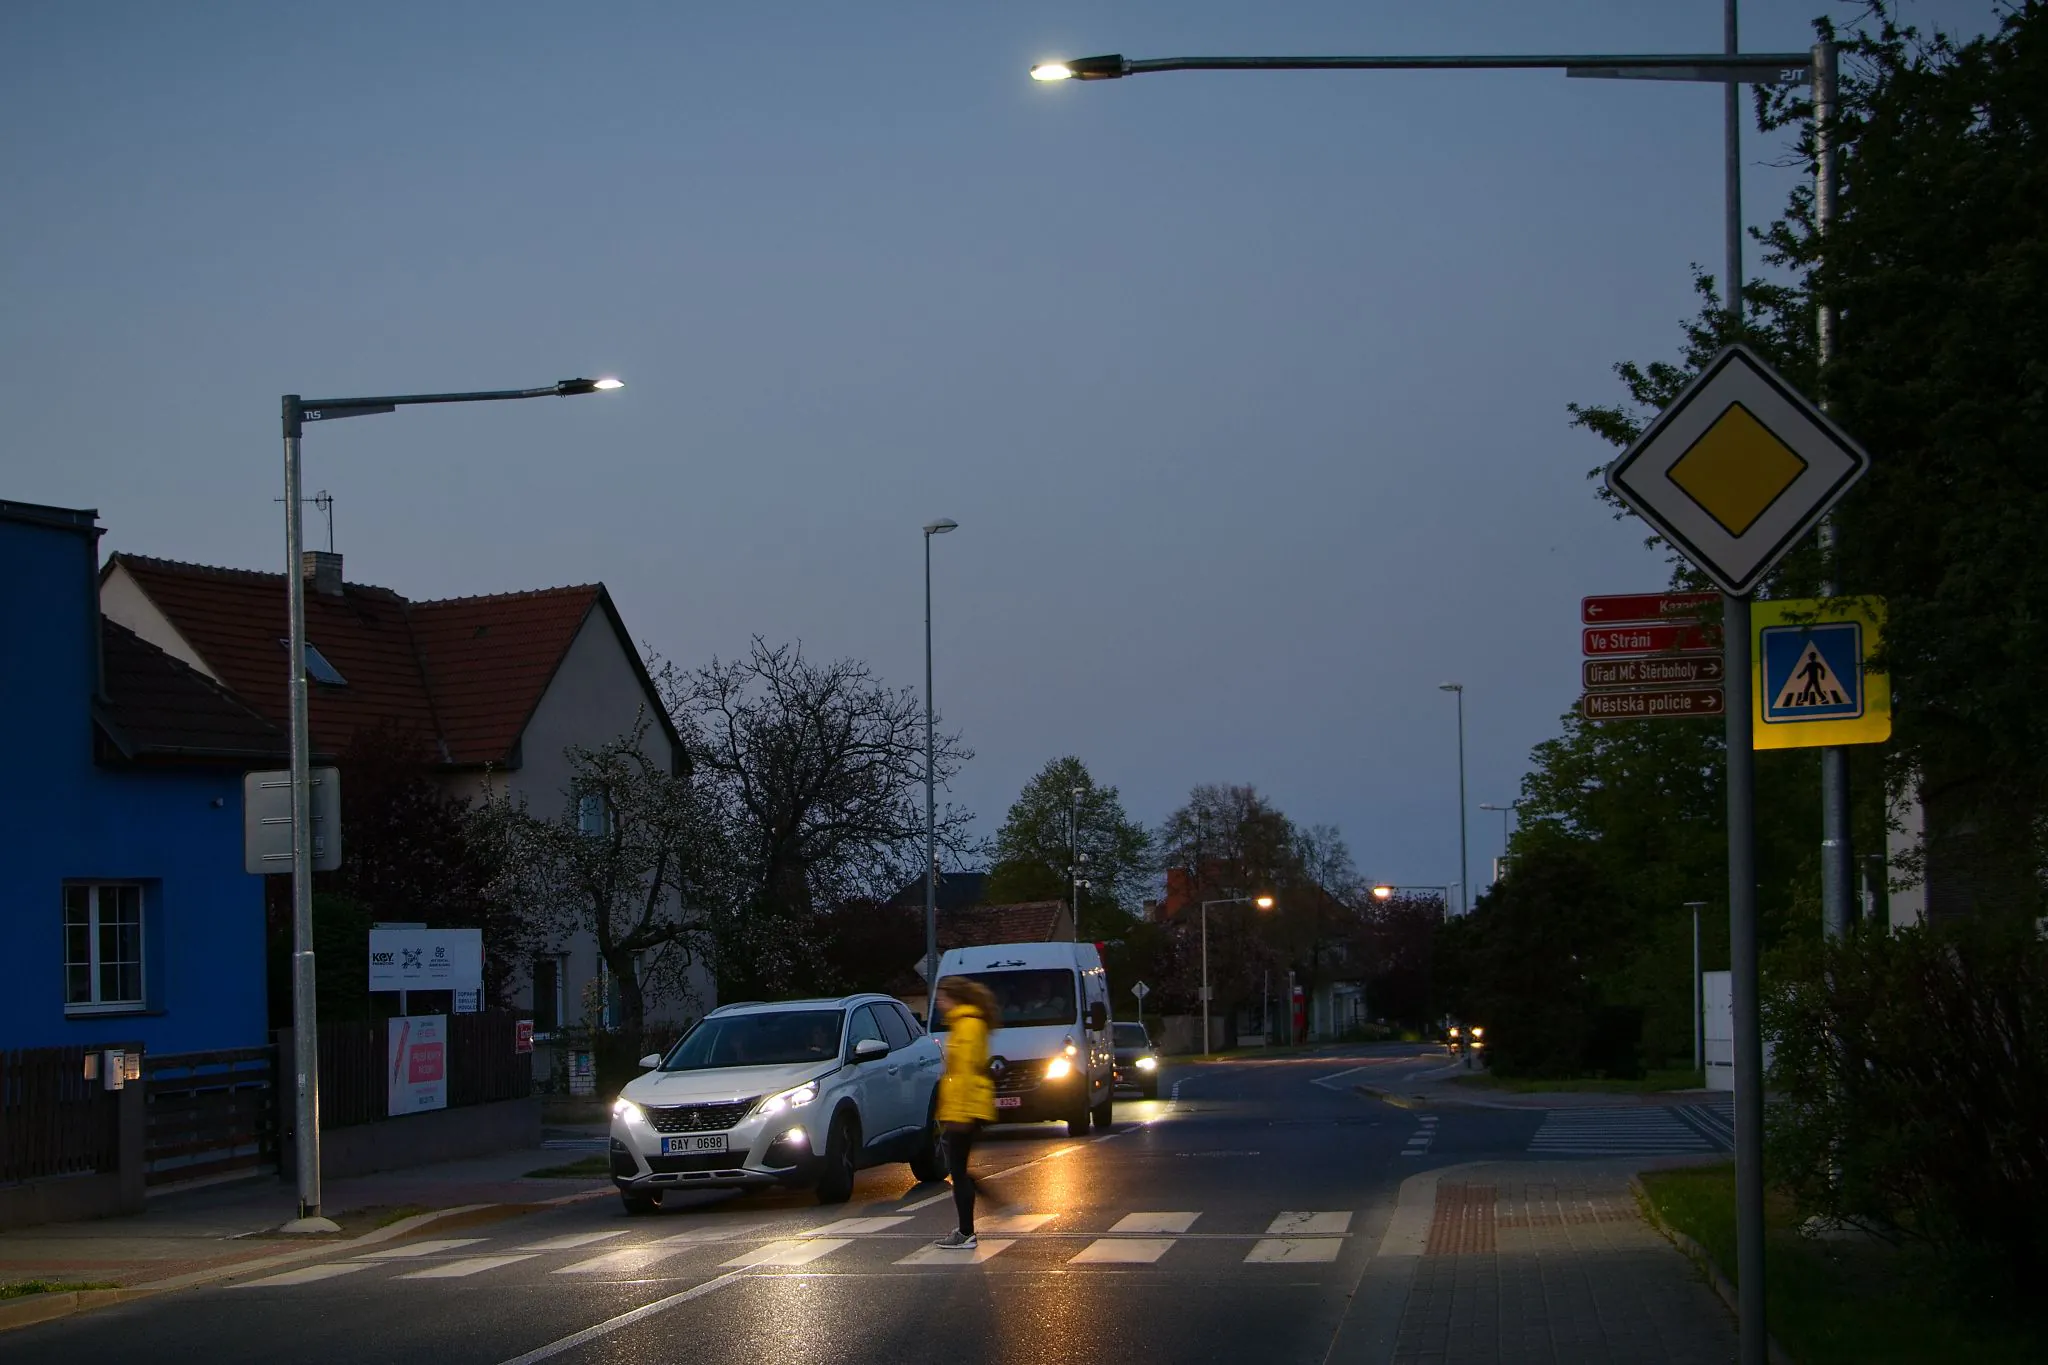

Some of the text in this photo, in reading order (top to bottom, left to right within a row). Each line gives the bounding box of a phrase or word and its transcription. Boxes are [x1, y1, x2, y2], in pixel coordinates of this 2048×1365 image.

[1591, 632, 1651, 650] Ve Stráni
[1591, 661, 1697, 682] Úřad MČ Štěrboholy
[1591, 693, 1691, 714] Městská policie
[671, 1137, 722, 1150] 6AY 0698
